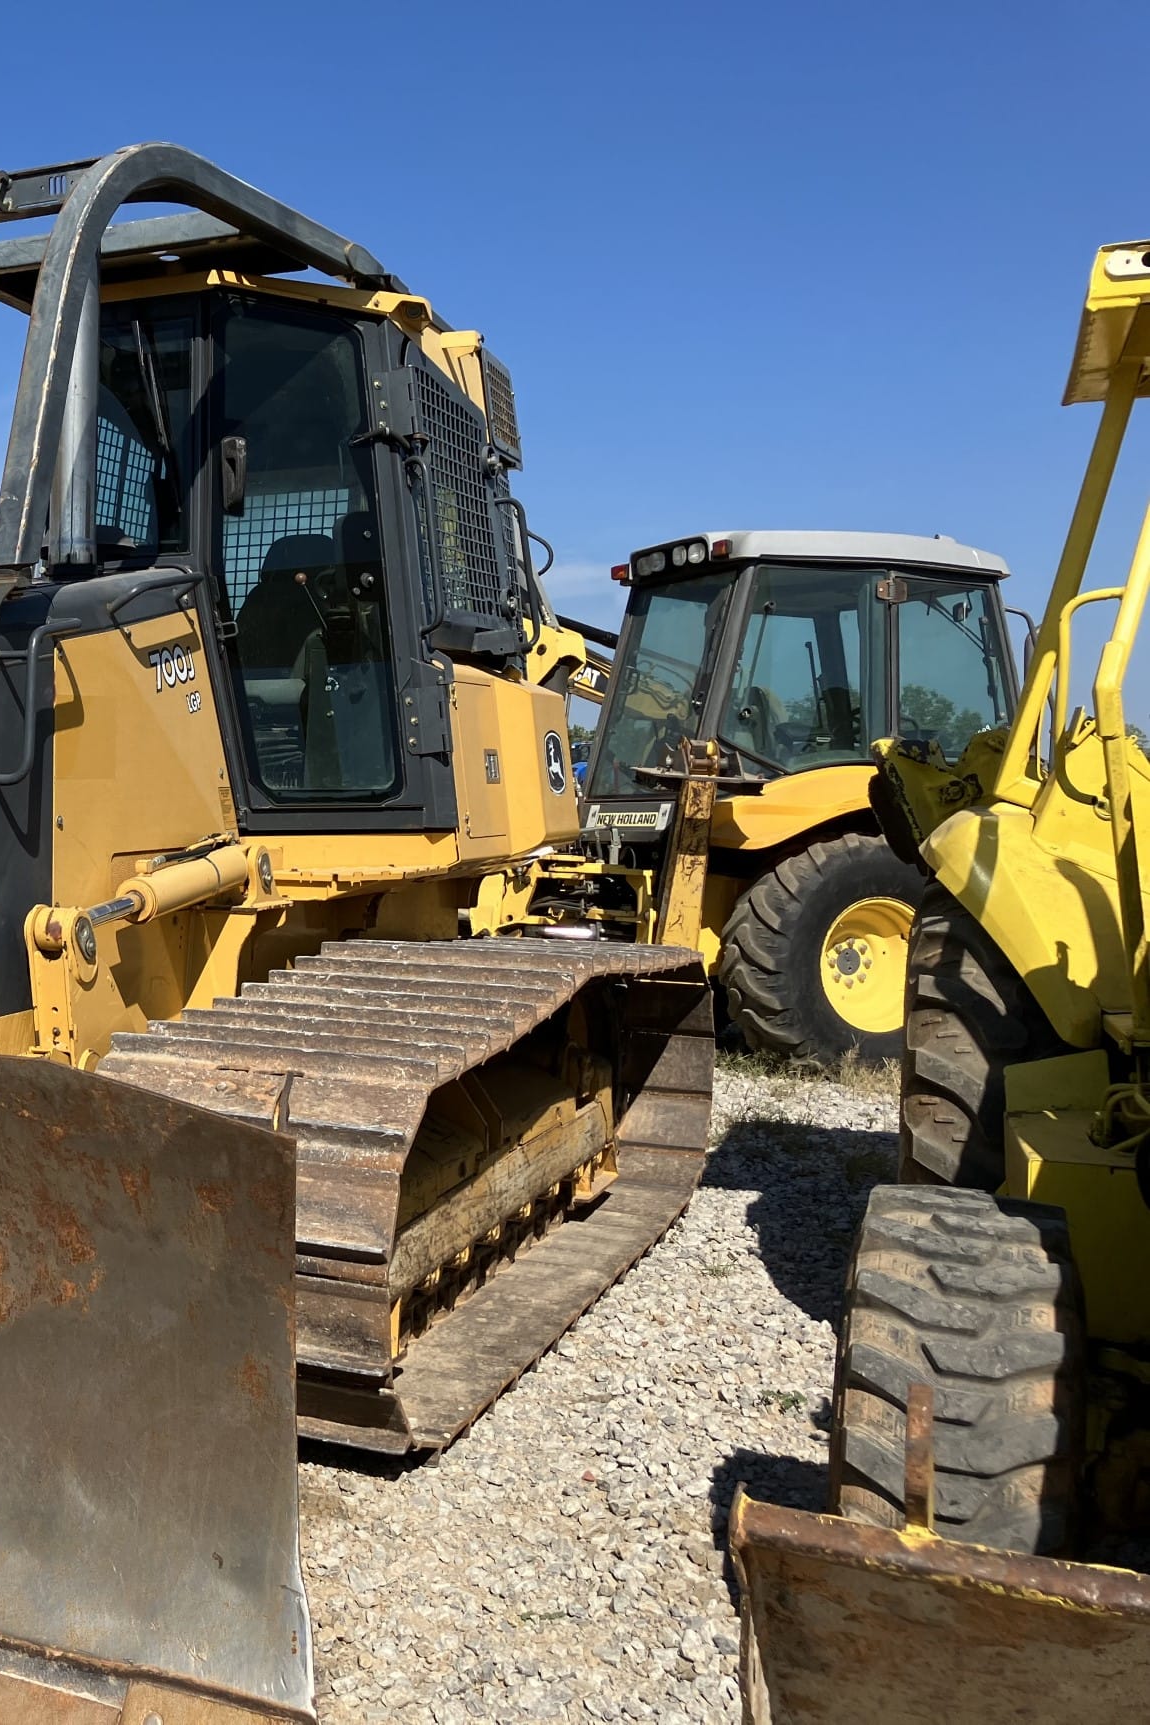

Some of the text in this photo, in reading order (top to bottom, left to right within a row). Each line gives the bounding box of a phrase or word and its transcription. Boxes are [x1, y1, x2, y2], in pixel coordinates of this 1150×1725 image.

[149, 645, 195, 692] 700J
[596, 813, 657, 825] NEW HOLLAND
